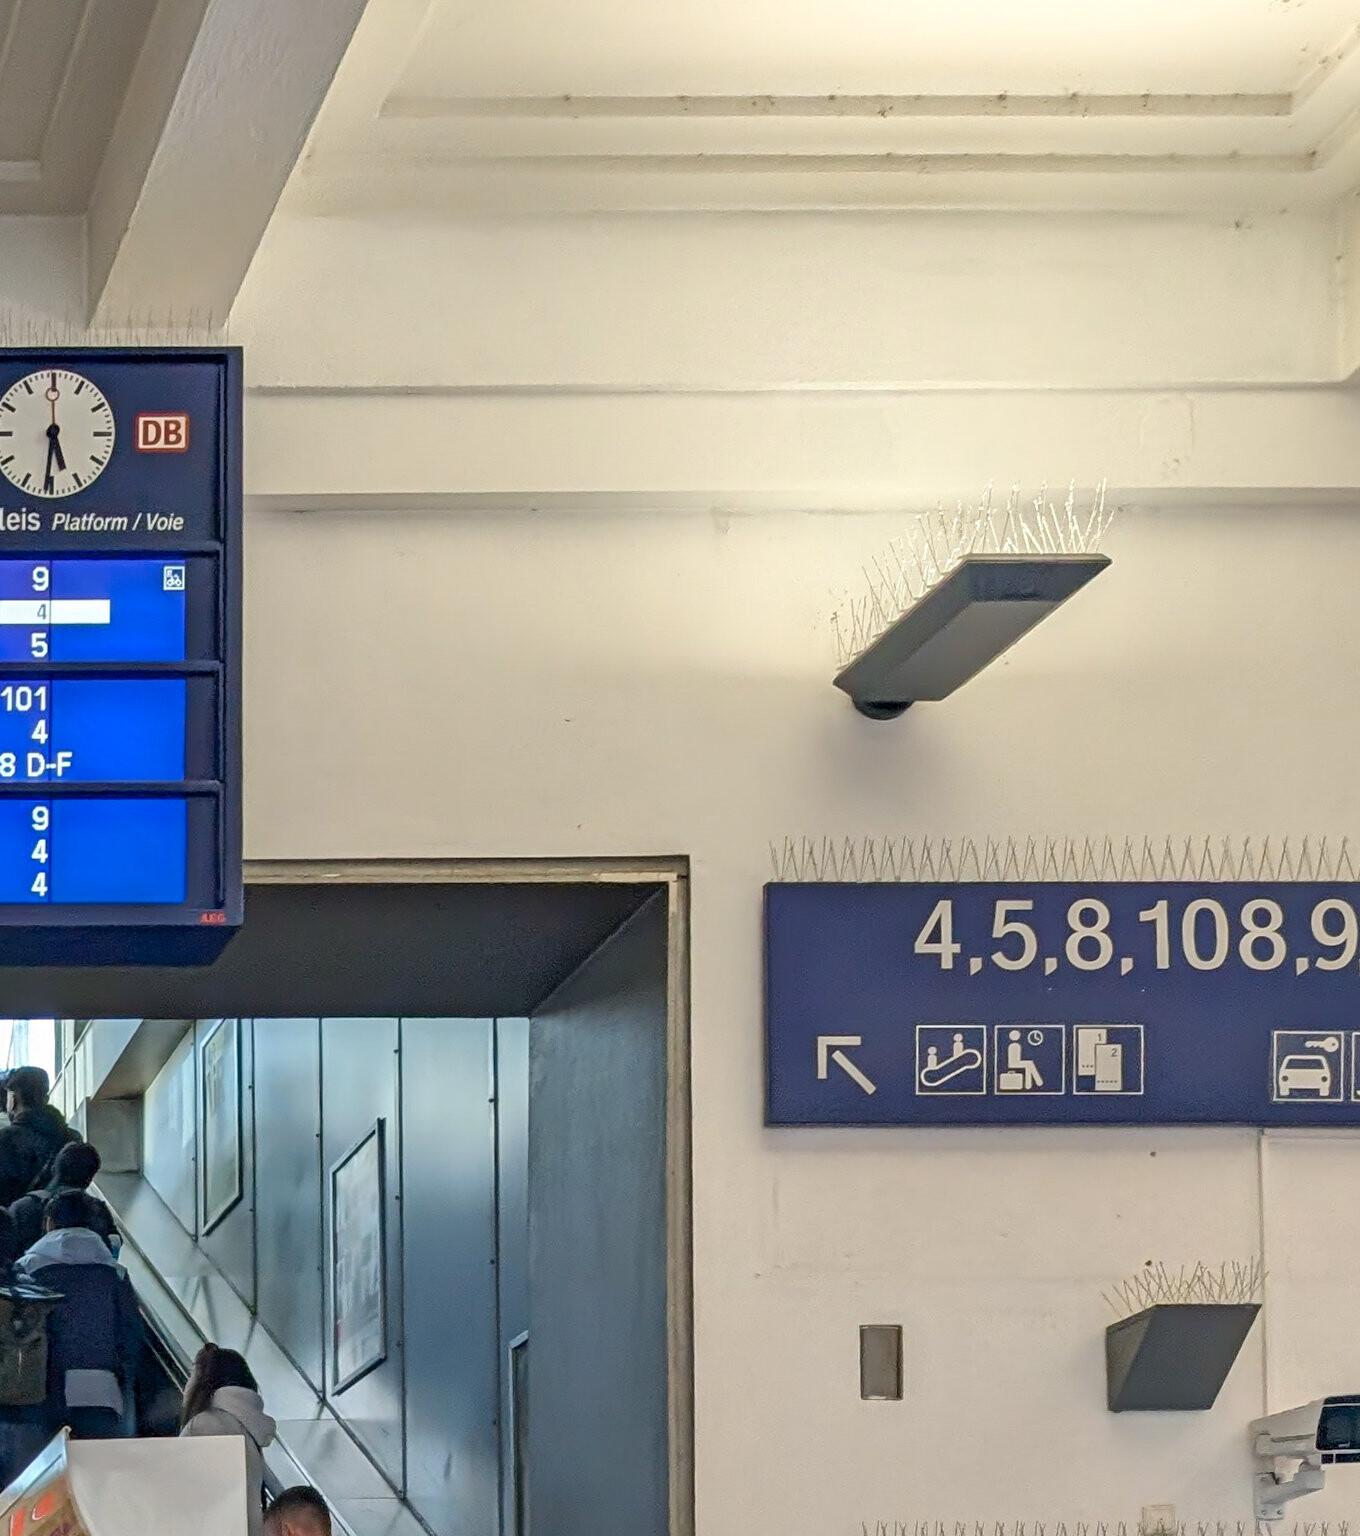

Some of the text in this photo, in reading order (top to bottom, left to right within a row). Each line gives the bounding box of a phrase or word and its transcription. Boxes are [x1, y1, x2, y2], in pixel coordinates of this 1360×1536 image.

[141, 420, 183, 446] DB
[51, 512, 128, 531] Platform
[147, 512, 184, 531] Voie
[32, 567, 49, 591] 9
[37, 604, 48, 620] 4
[31, 633, 48, 657] 5
[0, 686, 47, 711] 101
[31, 720, 48, 744] 4
[0, 752, 73, 777] 8 D-F
[32, 806, 49, 830] 9
[31, 839, 48, 863] 4
[31, 872, 48, 896] 4
